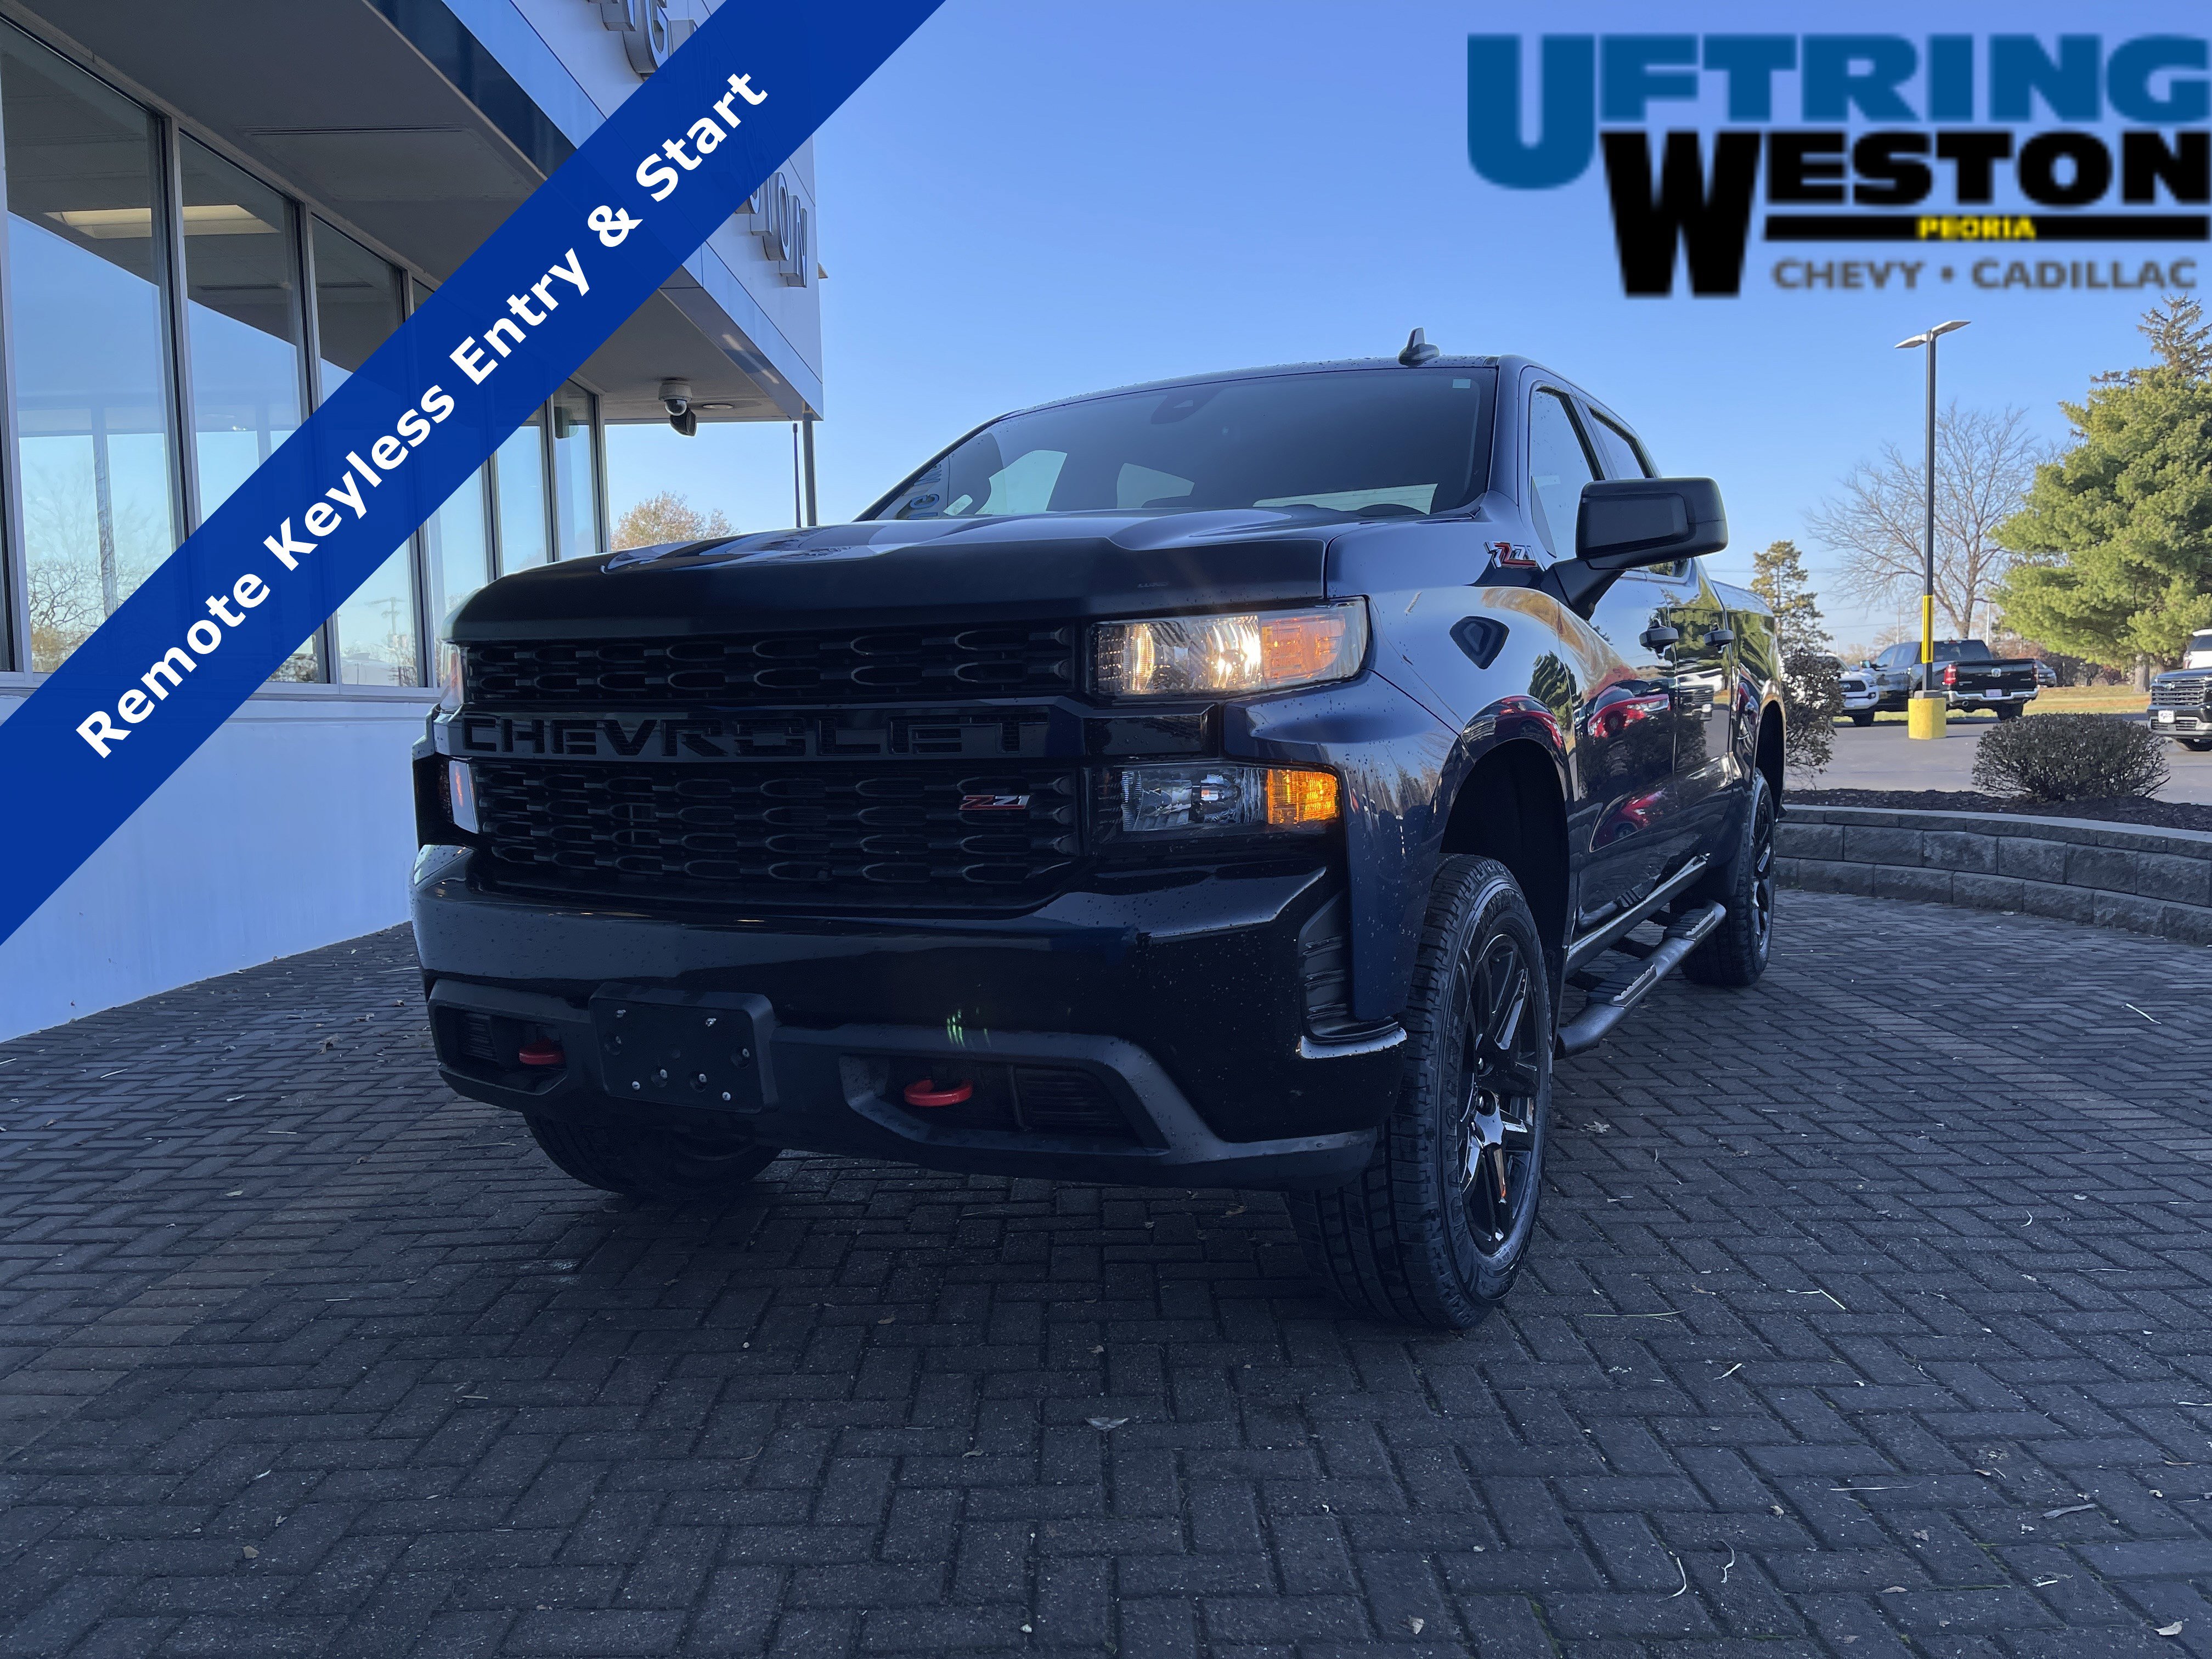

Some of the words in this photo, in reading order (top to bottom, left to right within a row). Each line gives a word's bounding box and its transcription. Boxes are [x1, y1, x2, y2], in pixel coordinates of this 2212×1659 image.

[1483, 540, 1538, 569] Z71
[461, 713, 1049, 756] CHEVROLET
[958, 794, 1030, 810] Z71
